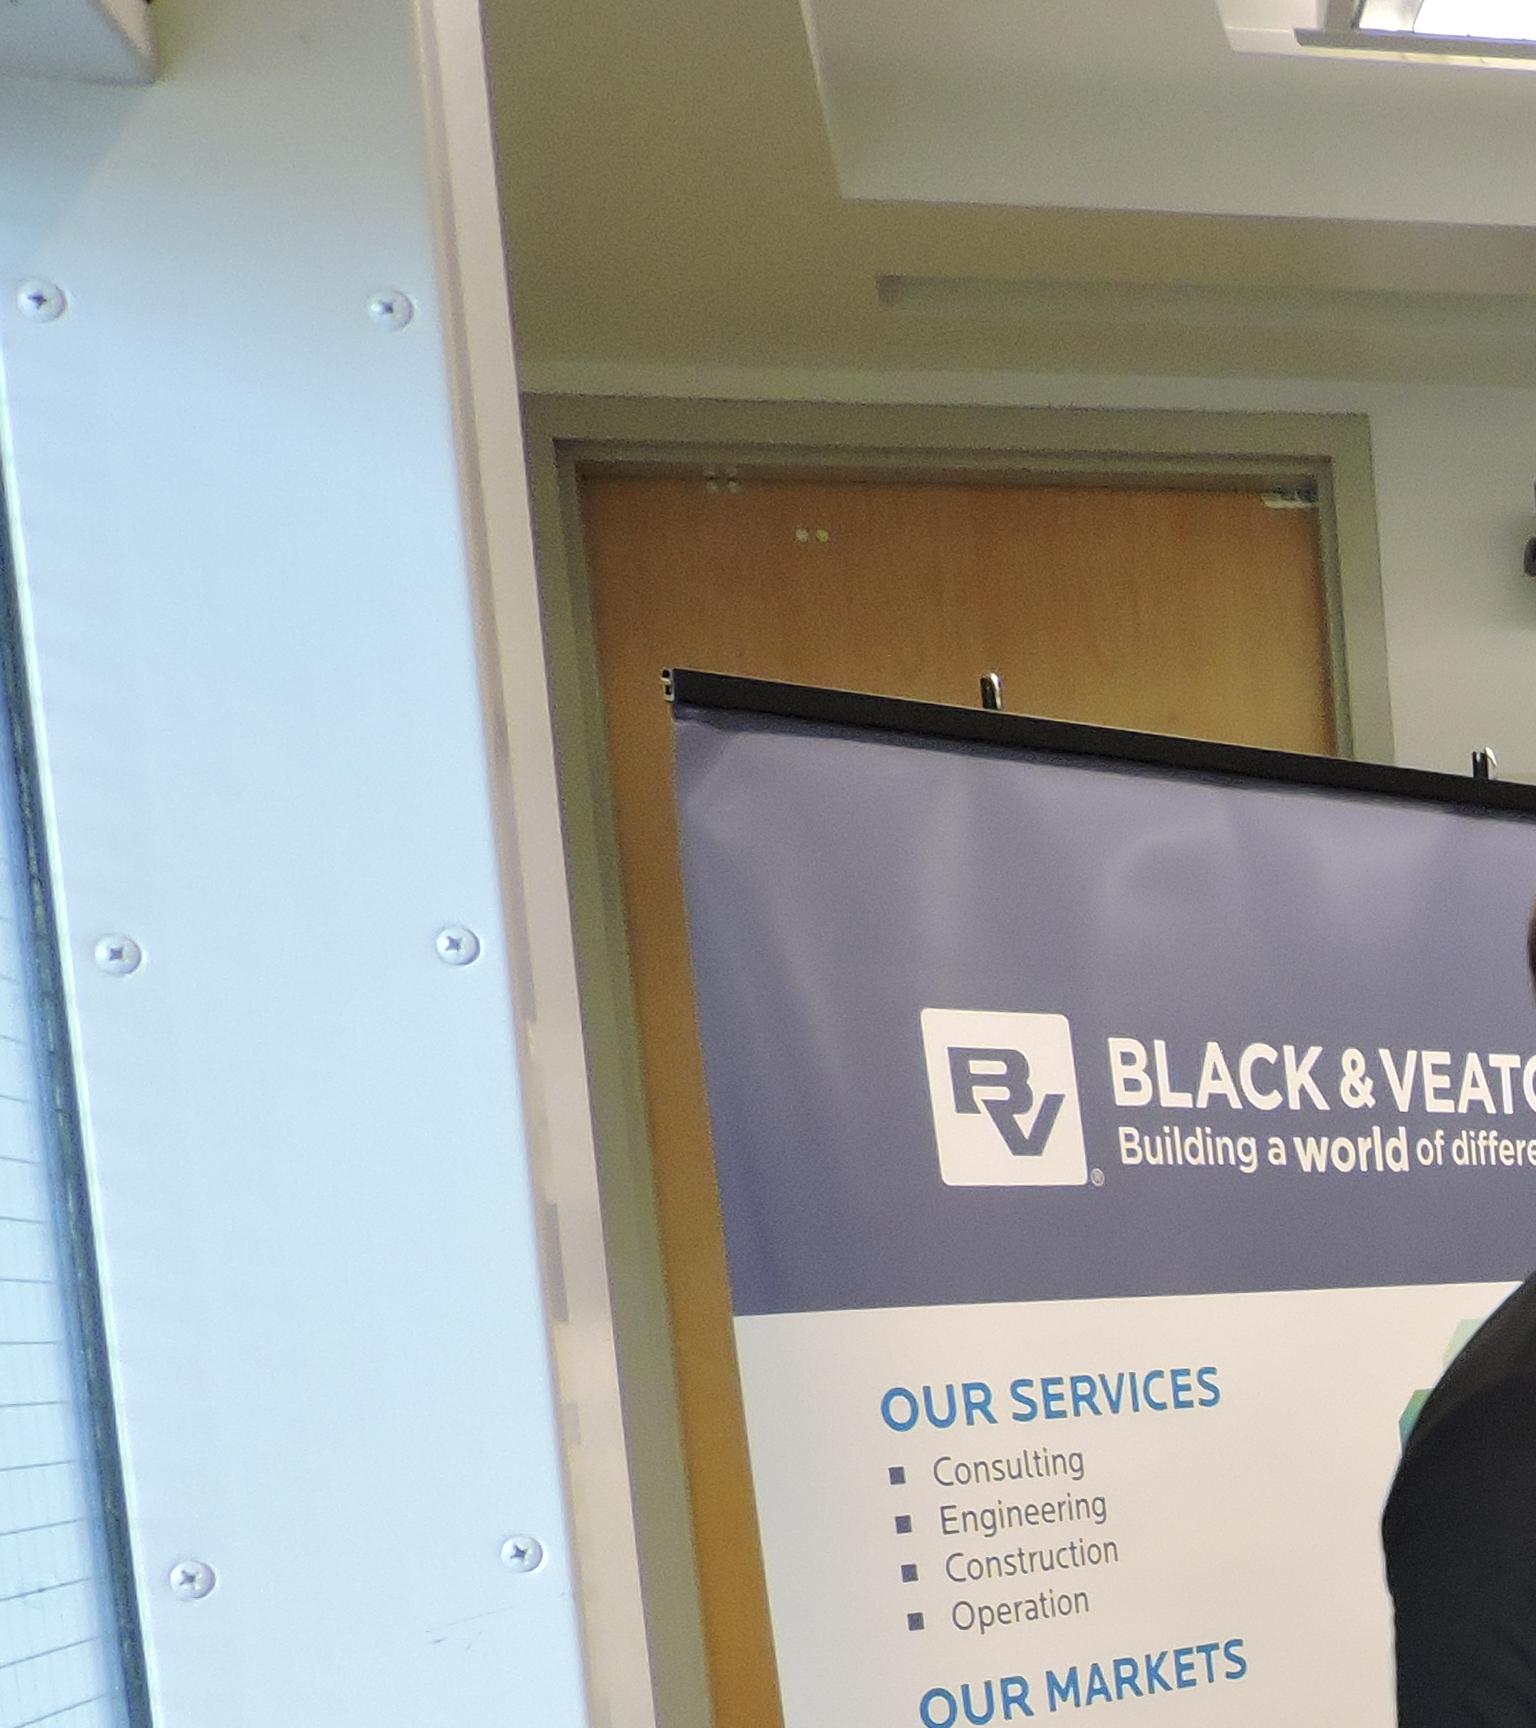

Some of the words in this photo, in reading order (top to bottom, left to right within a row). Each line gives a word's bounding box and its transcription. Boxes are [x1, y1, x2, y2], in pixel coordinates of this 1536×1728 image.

[1107, 1037, 1331, 1111] BLACK
[1339, 1050, 1375, 1109] &
[1118, 1126, 1258, 1175] Building
[1268, 1138, 1288, 1166] a
[1297, 1126, 1409, 1174] world
[1416, 1132, 1445, 1167] of
[881, 1382, 998, 1432] OUR
[1009, 1366, 1222, 1423] SERVICES
[932, 1448, 1086, 1487] Consulting
[940, 1492, 1108, 1538] Engineering
[945, 1536, 1119, 1584] Construction
[951, 1588, 1090, 1635] Operation
[1045, 1638, 1248, 1714] MARKETS
